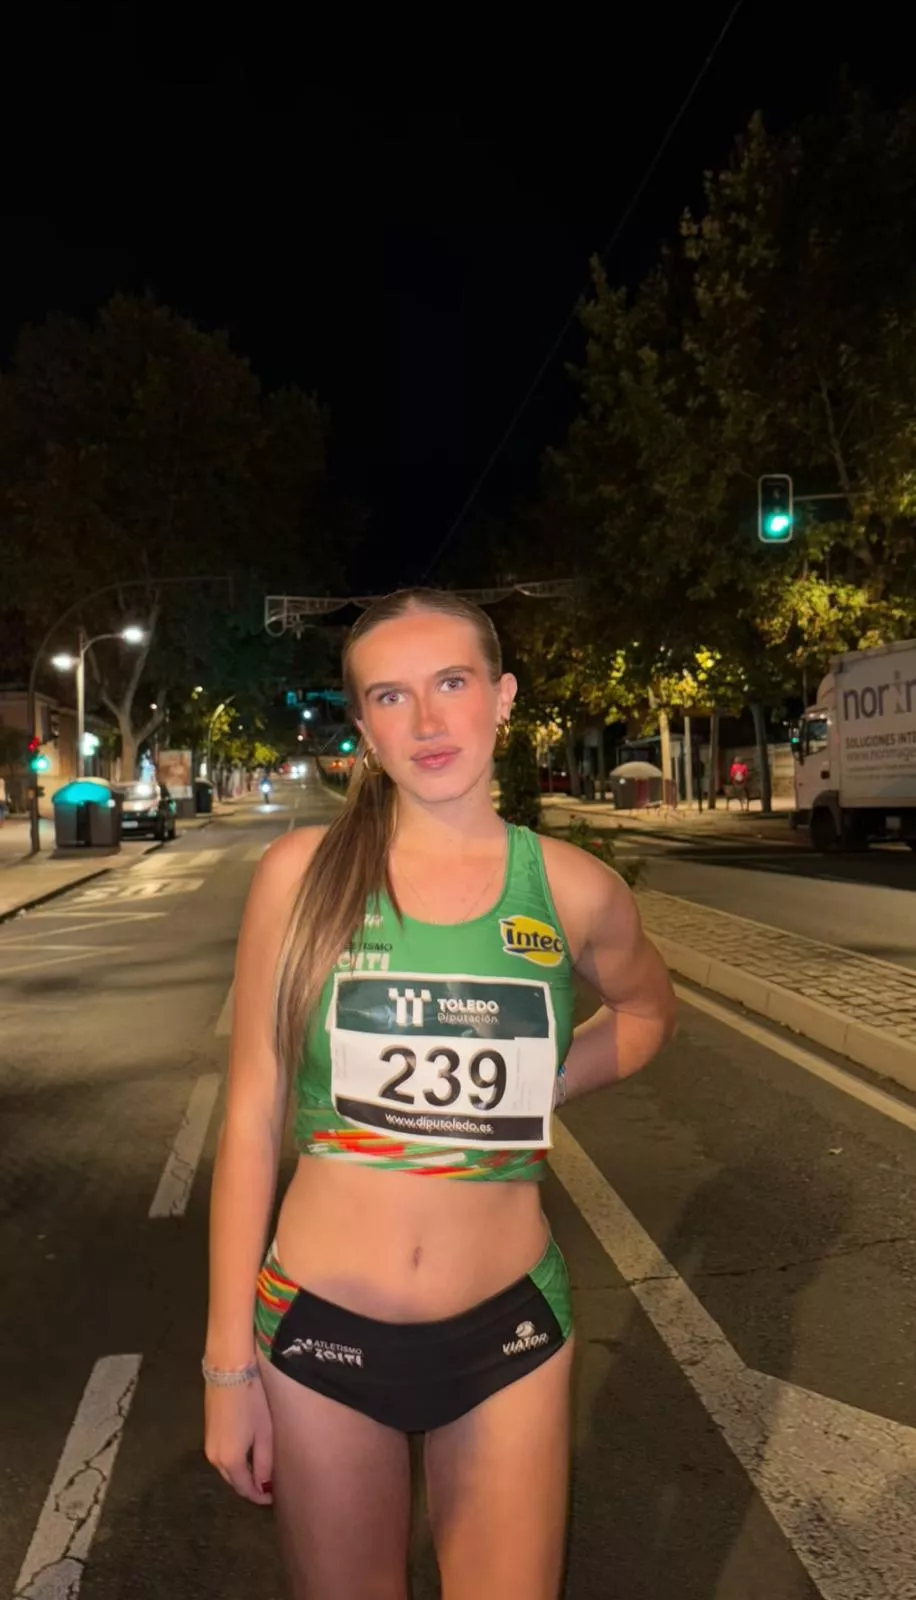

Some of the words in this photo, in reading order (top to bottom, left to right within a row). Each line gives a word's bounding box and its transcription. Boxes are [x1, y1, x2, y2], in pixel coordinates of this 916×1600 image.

[846, 733, 896, 749] SOLUCIONES
[437, 998, 500, 1014] TOLEDO
[437, 1012, 500, 1025] Diputación
[378, 1044, 507, 1111] 239
[385, 1113, 494, 1135] www.diputoledo.es
[314, 1339, 363, 1355] ATLETISMO
[502, 1332, 549, 1355] VIATOR
